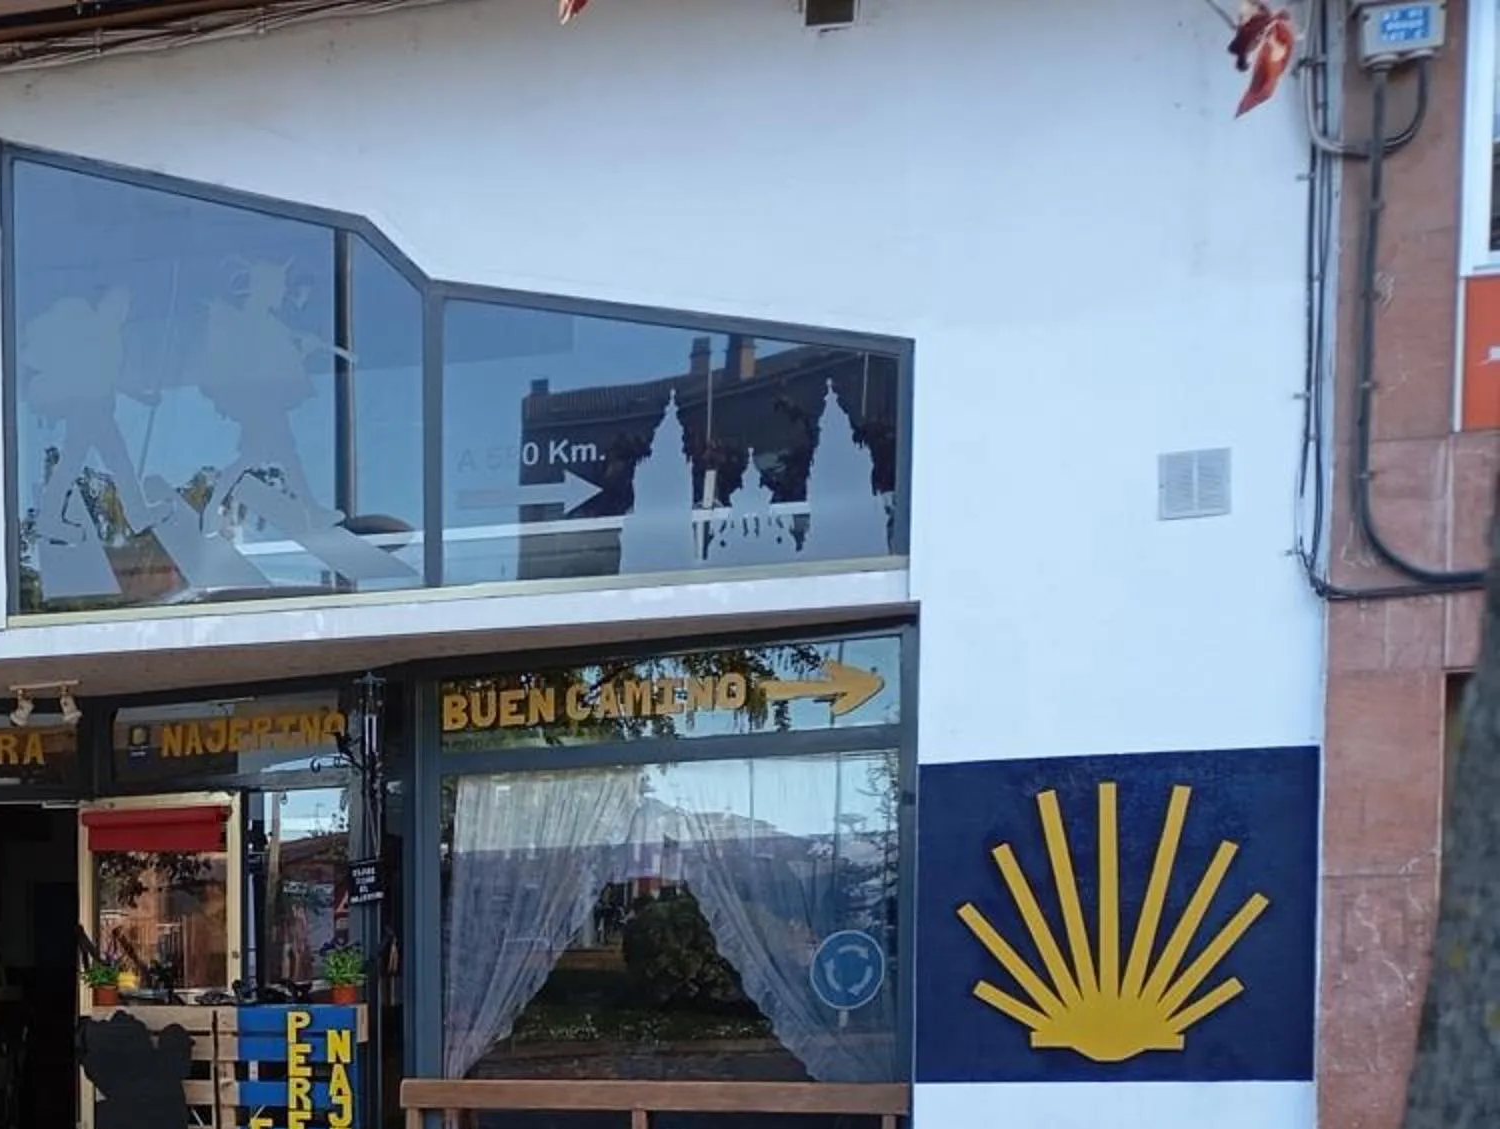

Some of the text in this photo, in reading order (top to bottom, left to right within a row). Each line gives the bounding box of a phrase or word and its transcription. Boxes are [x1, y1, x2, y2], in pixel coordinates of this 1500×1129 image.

[549, 438, 606, 465] Km.
[442, 671, 747, 732] BUEN CAMINO
[160, 710, 347, 758] NAJERINO
